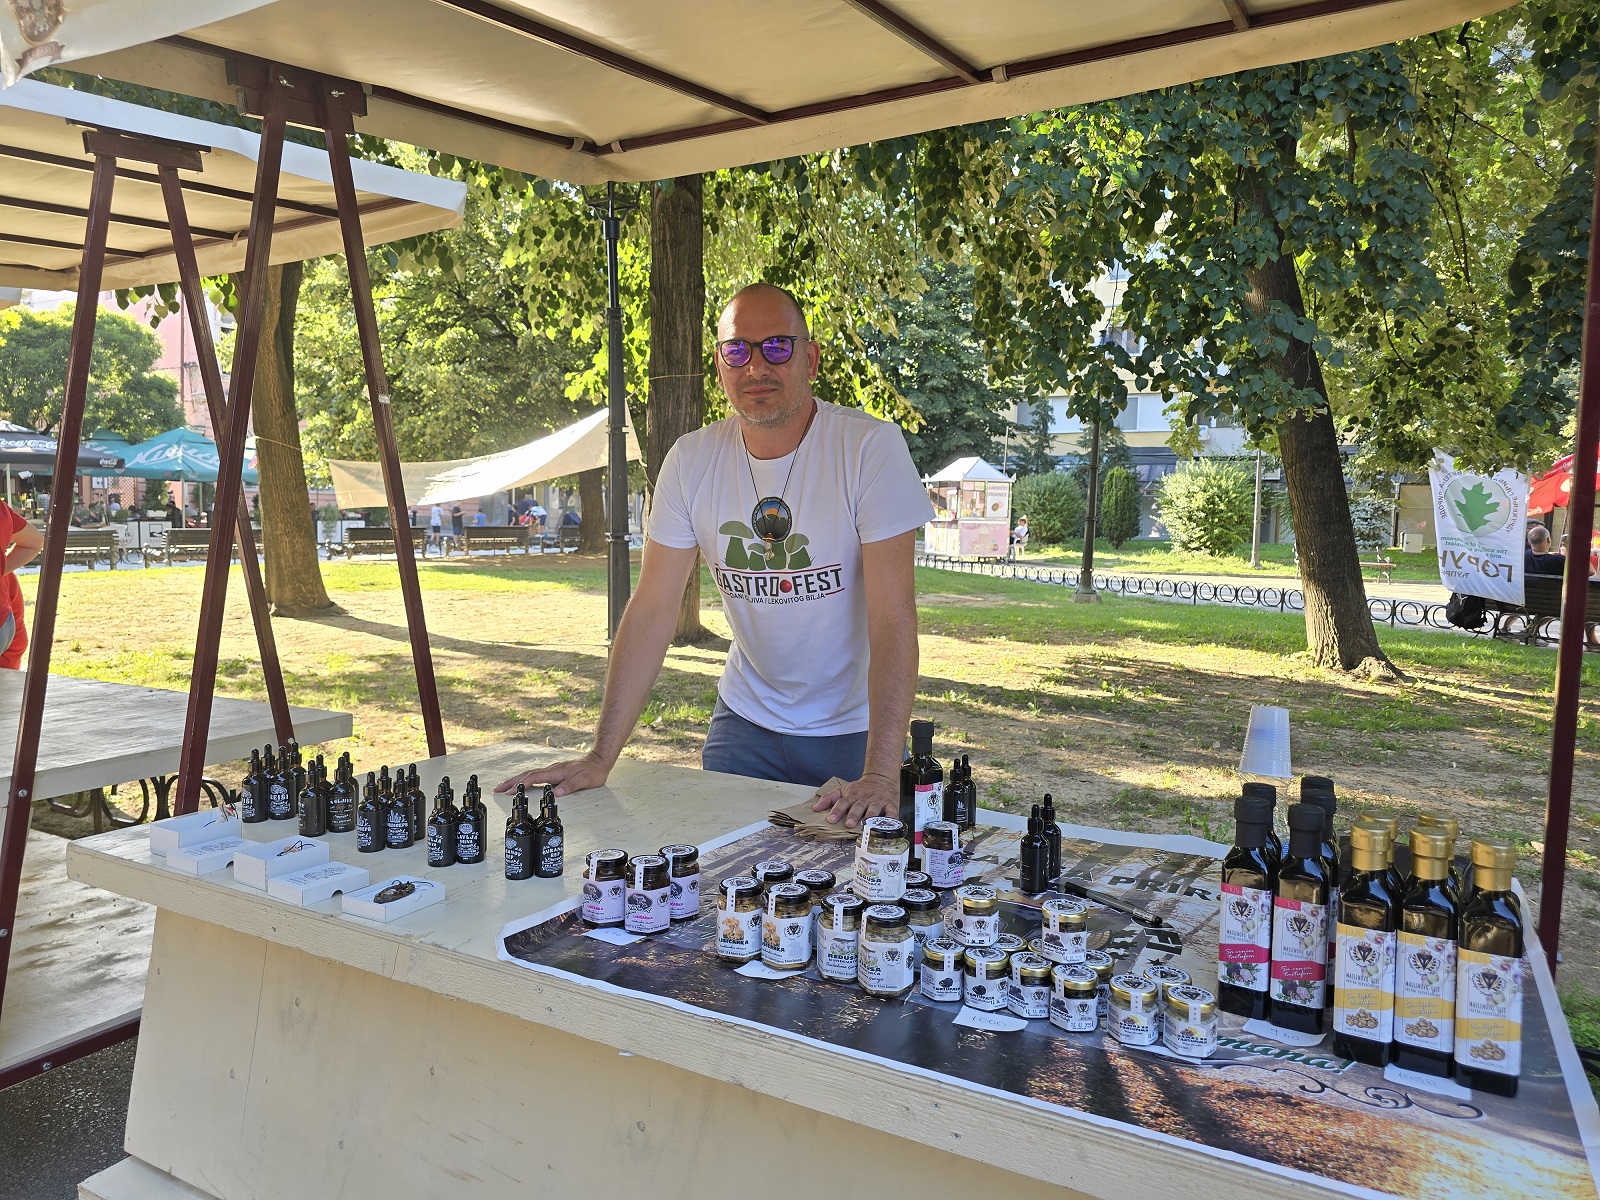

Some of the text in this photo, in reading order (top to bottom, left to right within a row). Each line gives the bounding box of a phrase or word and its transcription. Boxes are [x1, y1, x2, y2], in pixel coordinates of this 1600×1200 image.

[715, 567, 842, 597] GASTRO FEST
[730, 592, 744, 600] DANI
[768, 595, 805, 605] LEKOVITOG
[806, 592, 826, 602] BILJA
[1108, 875, 1220, 902] PRIR
